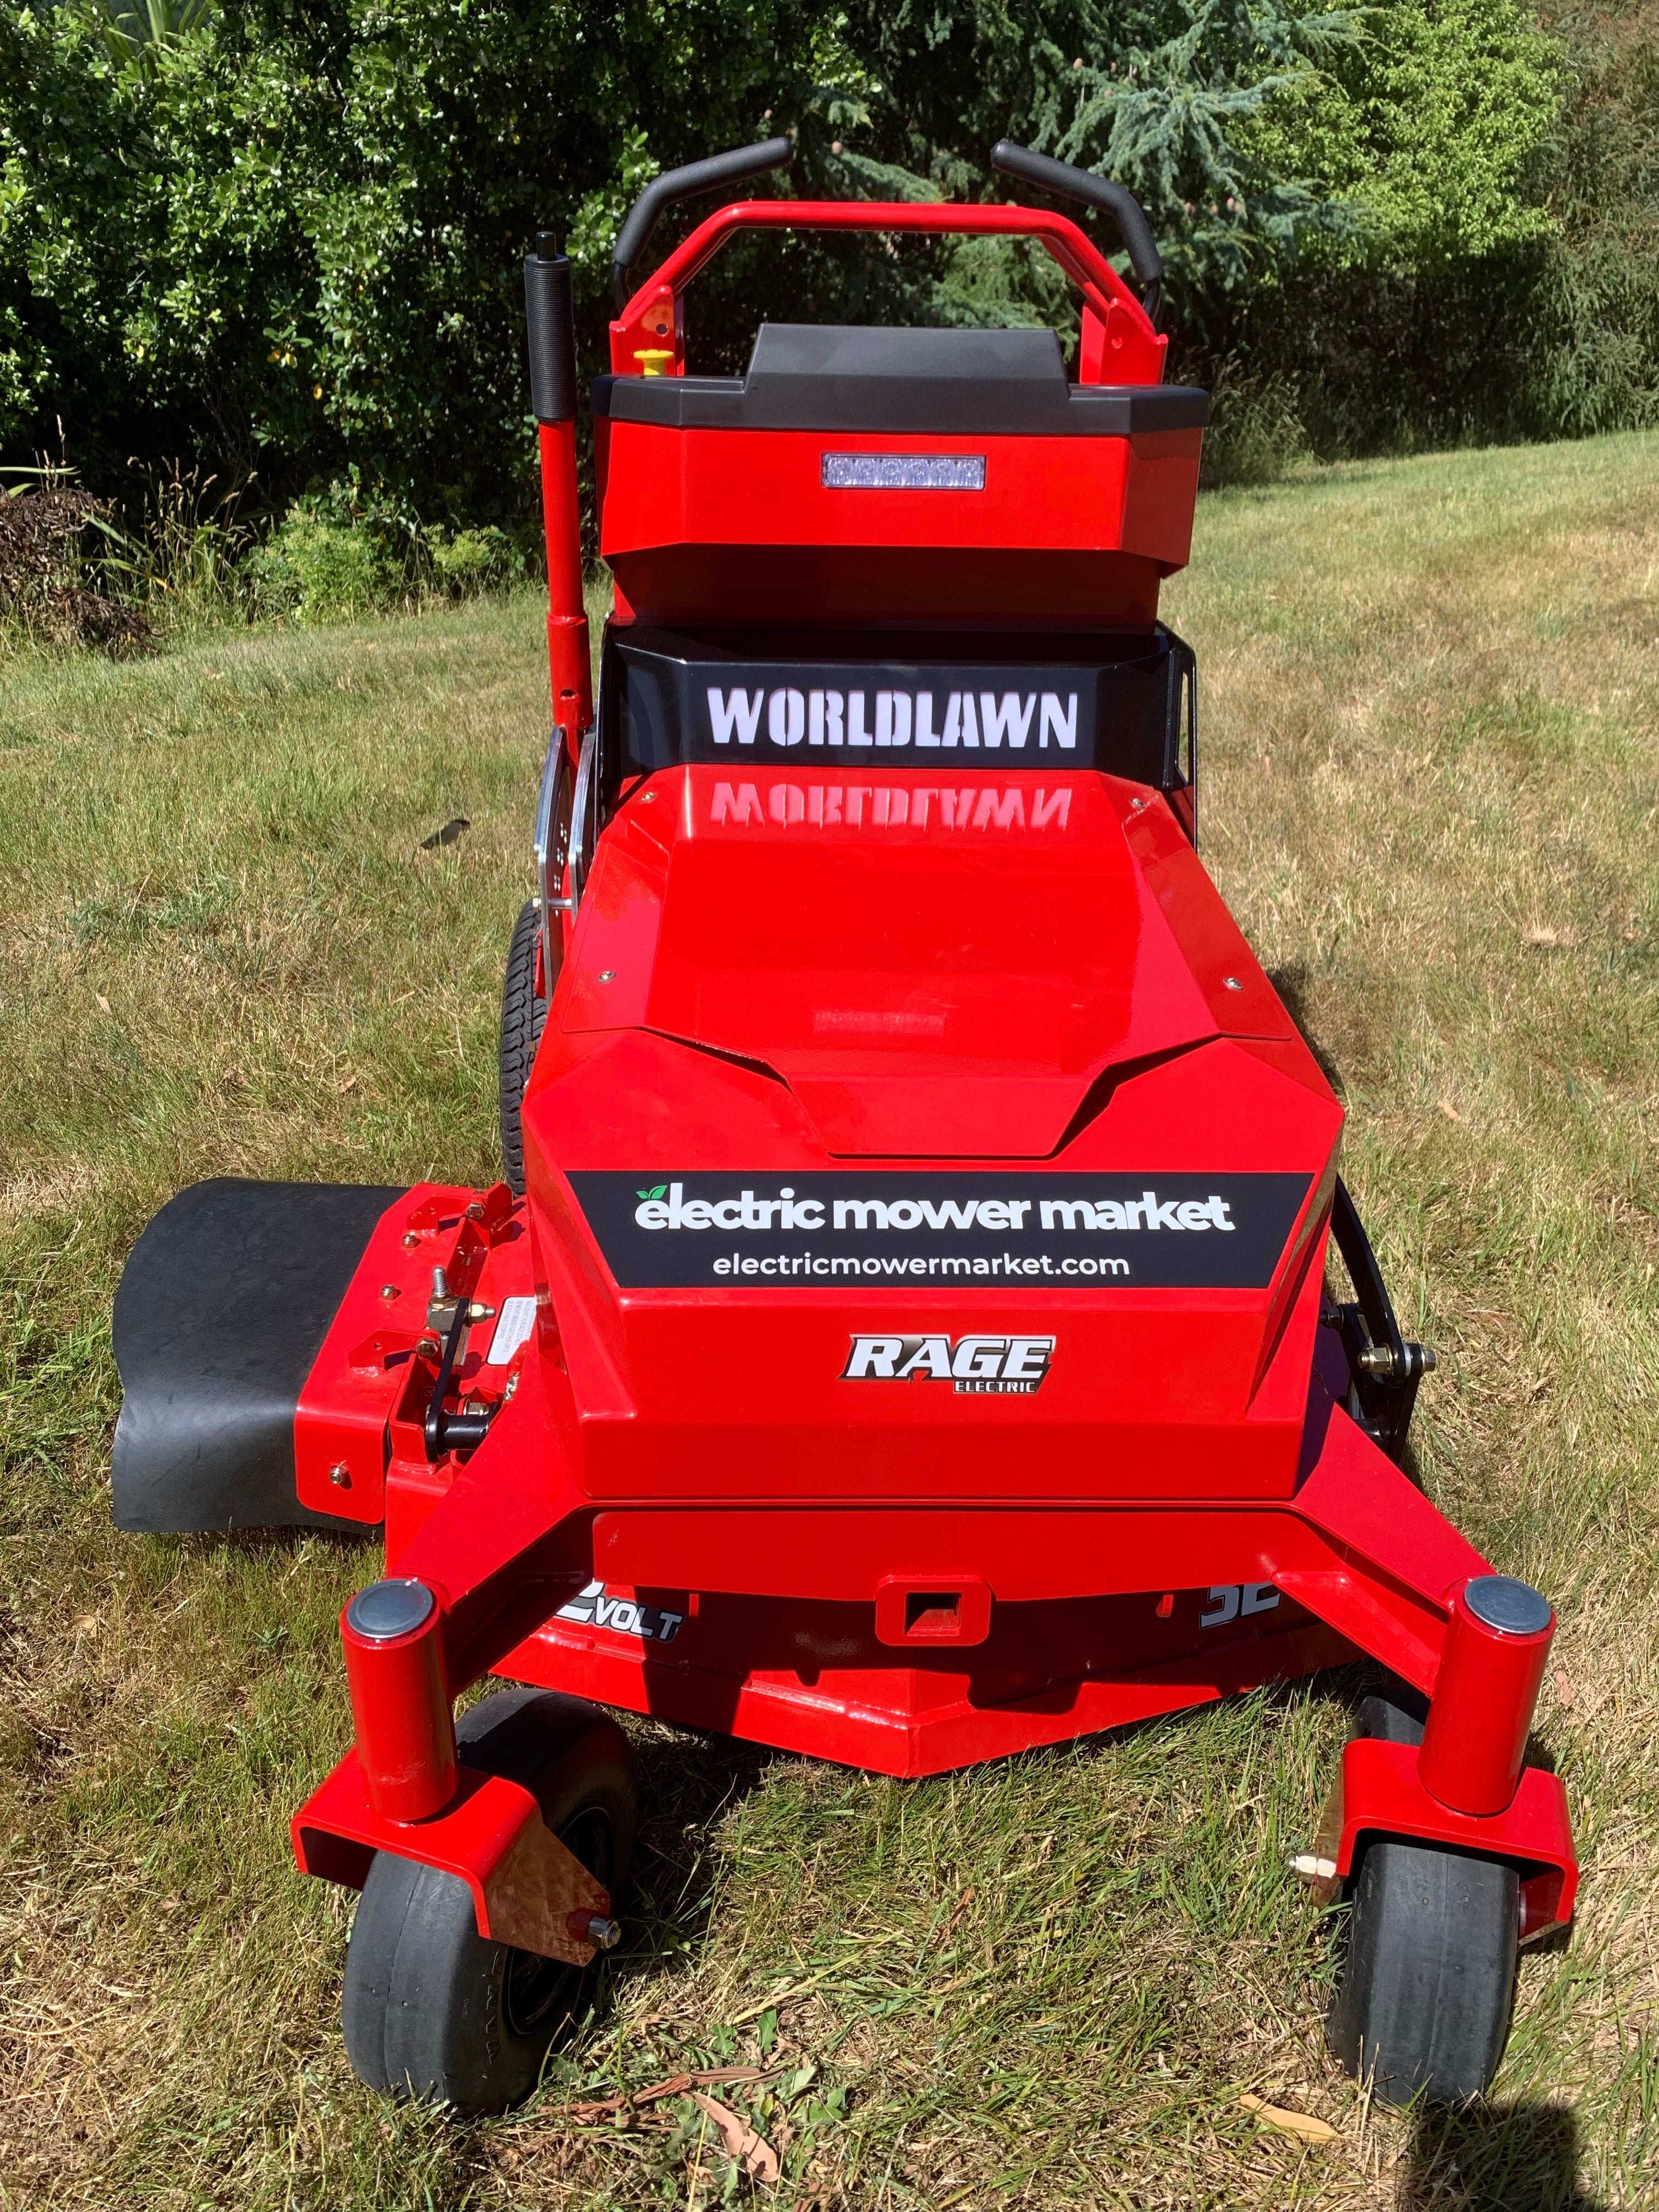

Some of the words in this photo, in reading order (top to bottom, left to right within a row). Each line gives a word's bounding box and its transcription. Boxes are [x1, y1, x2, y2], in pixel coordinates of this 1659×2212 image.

[707, 687, 1078, 748] WORLDLAWN
[635, 1183, 826, 1229] electric
[833, 1199, 1031, 1230] mower
[1040, 1192, 1236, 1231] market
[713, 1252, 1130, 1276] electricmowermarket.com
[845, 1338, 1053, 1378] RAGE
[955, 1381, 1036, 1393] ELECTRIC
[595, 1596, 682, 1640] VOLT
